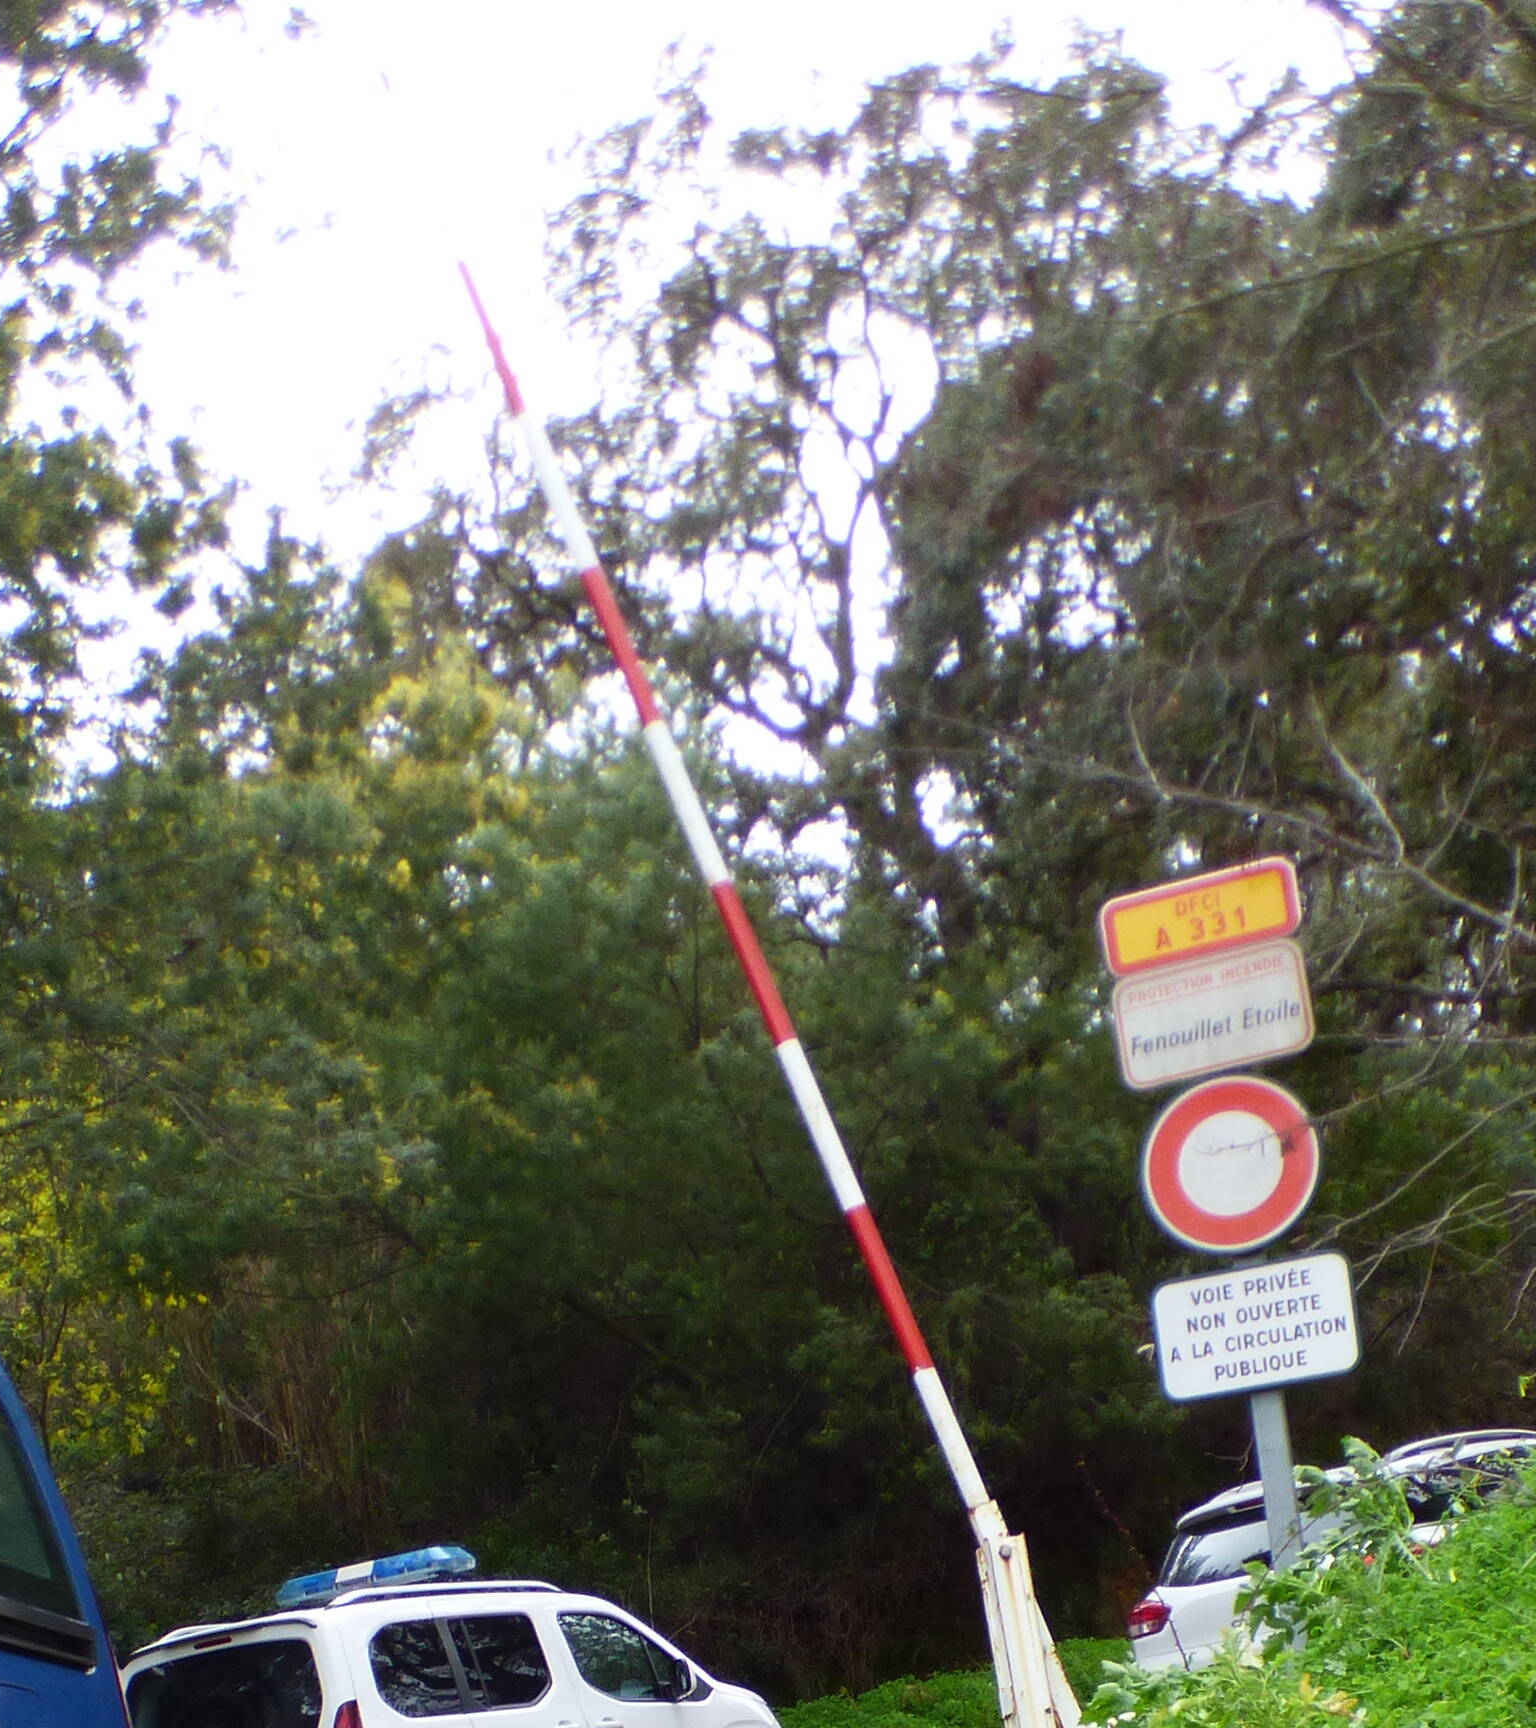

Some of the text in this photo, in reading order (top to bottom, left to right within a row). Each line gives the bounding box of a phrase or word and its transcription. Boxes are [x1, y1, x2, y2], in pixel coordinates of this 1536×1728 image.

[1175, 890, 1221, 917] DFCI
[1156, 906, 1247, 951] A 331
[1128, 973, 1214, 1005] PROTECTION
[1131, 1017, 1232, 1057] Fenouillet
[1190, 1268, 1312, 1306] VOIE PRIVÉE
[1186, 1294, 1322, 1334] NON OUVERTE
[1170, 1316, 1347, 1363] A LA CIRCULATION
[1214, 1350, 1308, 1381] PUBLIQUE
